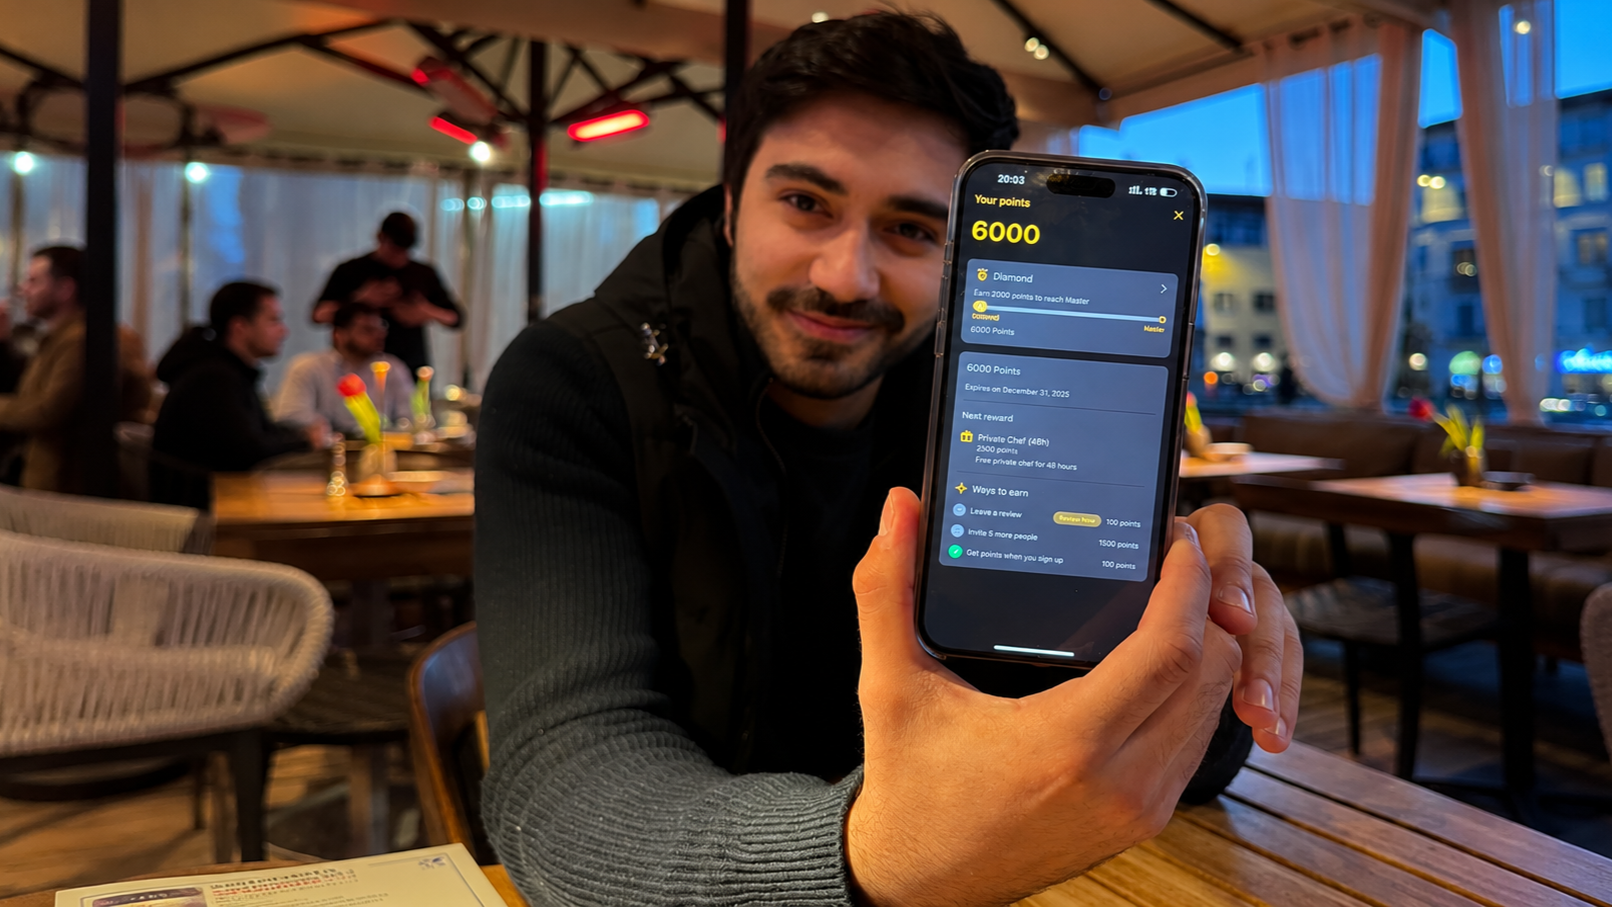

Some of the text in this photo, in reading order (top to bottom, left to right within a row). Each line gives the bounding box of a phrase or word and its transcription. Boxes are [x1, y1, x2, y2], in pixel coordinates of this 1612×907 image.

[997, 174, 1025, 185] 20:03
[974, 194, 1031, 208] Your points
[972, 220, 1041, 245] 6000
[993, 272, 1033, 283] Diamond
[974, 288, 990, 297] Earn
[991, 290, 1010, 298] 2000
[1012, 293, 1034, 301] points
[1044, 295, 1064, 303] reach
[1065, 296, 1090, 305] Master
[970, 326, 1015, 336] 6000 Points
[966, 363, 1021, 376] 6000 Points
[965, 383, 991, 393] Expires
[1002, 386, 1038, 397] December
[1039, 389, 1051, 398] 31,
[1051, 389, 1070, 398] 2025
[962, 411, 1014, 423] Next reward
[978, 434, 1006, 443] Private
[1007, 436, 1026, 445] Chef
[996, 447, 1018, 455] points
[975, 456, 992, 464] Free
[993, 458, 1017, 466] private
[1034, 460, 1045, 468] for
[1058, 462, 1077, 471] hours
[972, 485, 1029, 498] Ways to earn
[970, 507, 992, 516] Leave
[998, 510, 1023, 518] review
[1120, 520, 1141, 528] points
[968, 528, 987, 537] Invite
[1014, 533, 1038, 541] people
[1099, 539, 1139, 550] 1500 points
[966, 549, 980, 557] Get
[980, 550, 1002, 558] points
[1004, 553, 1022, 561] when
[1038, 555, 1053, 564] sign
[1102, 560, 1136, 570] 100 points
